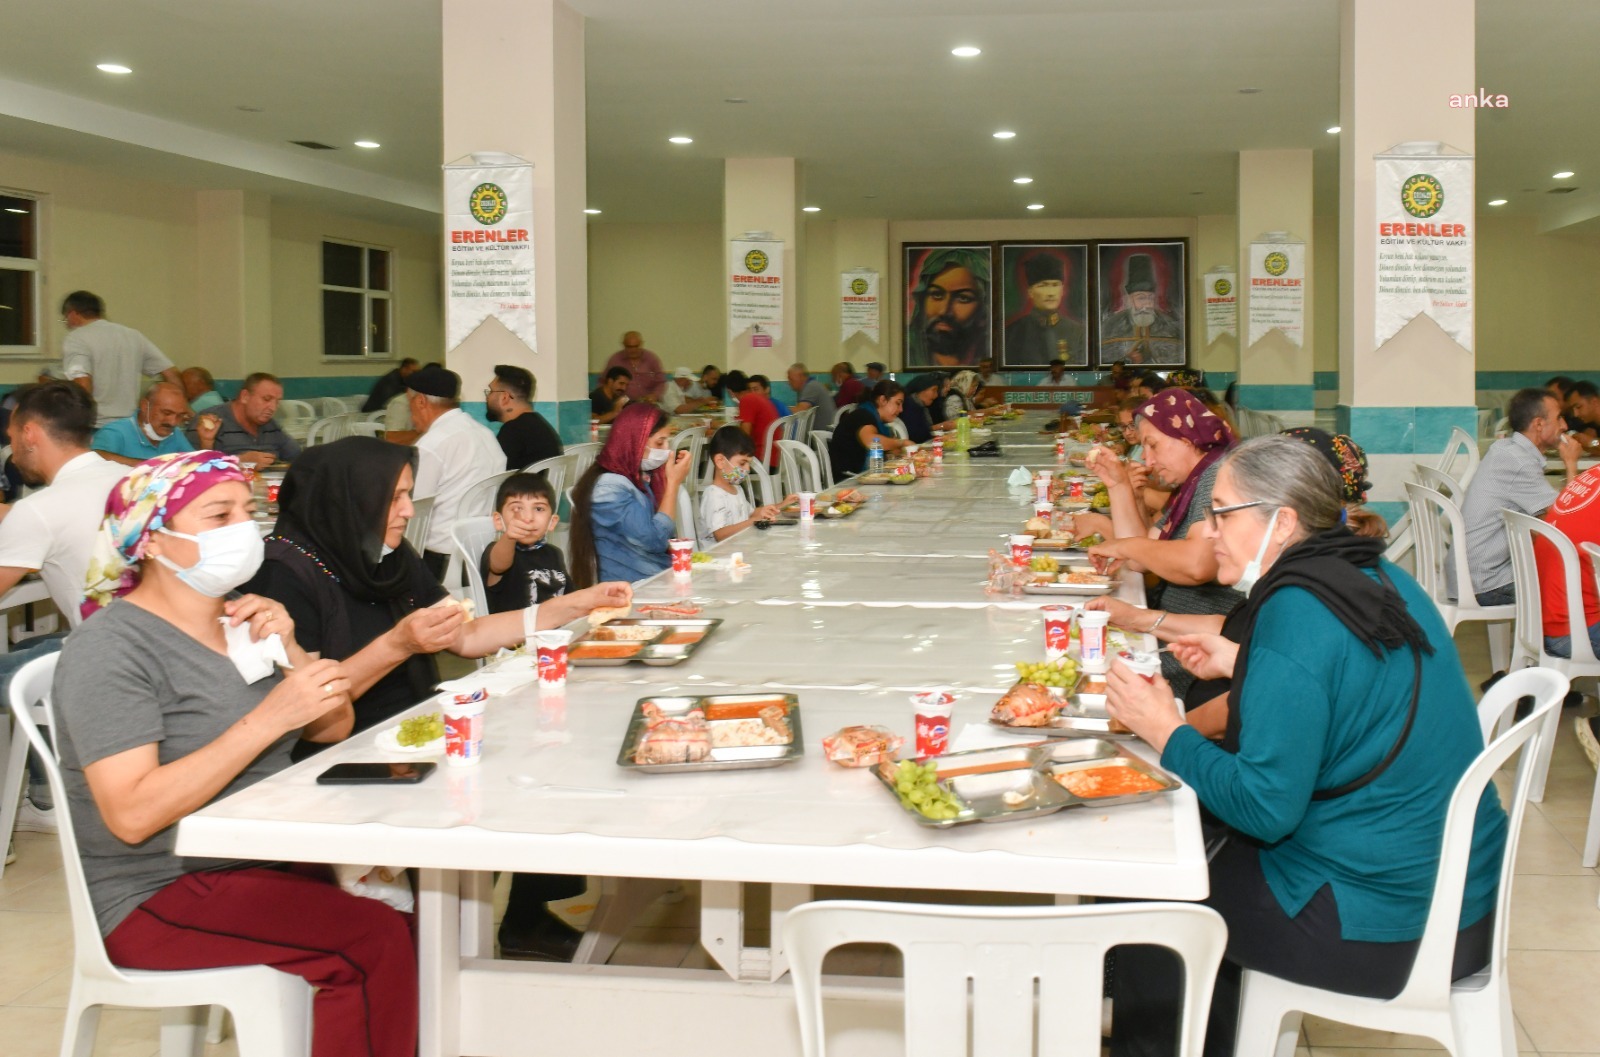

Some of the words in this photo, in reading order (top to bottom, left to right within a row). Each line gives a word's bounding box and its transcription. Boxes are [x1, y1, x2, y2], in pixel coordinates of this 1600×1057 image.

[451, 228, 530, 244] ERENLER
[1379, 222, 1466, 238] ERENLER
[732, 275, 781, 284] ERENLER
[1251, 278, 1302, 286] ERENLER
[1005, 391, 1050, 404] ERENLER
